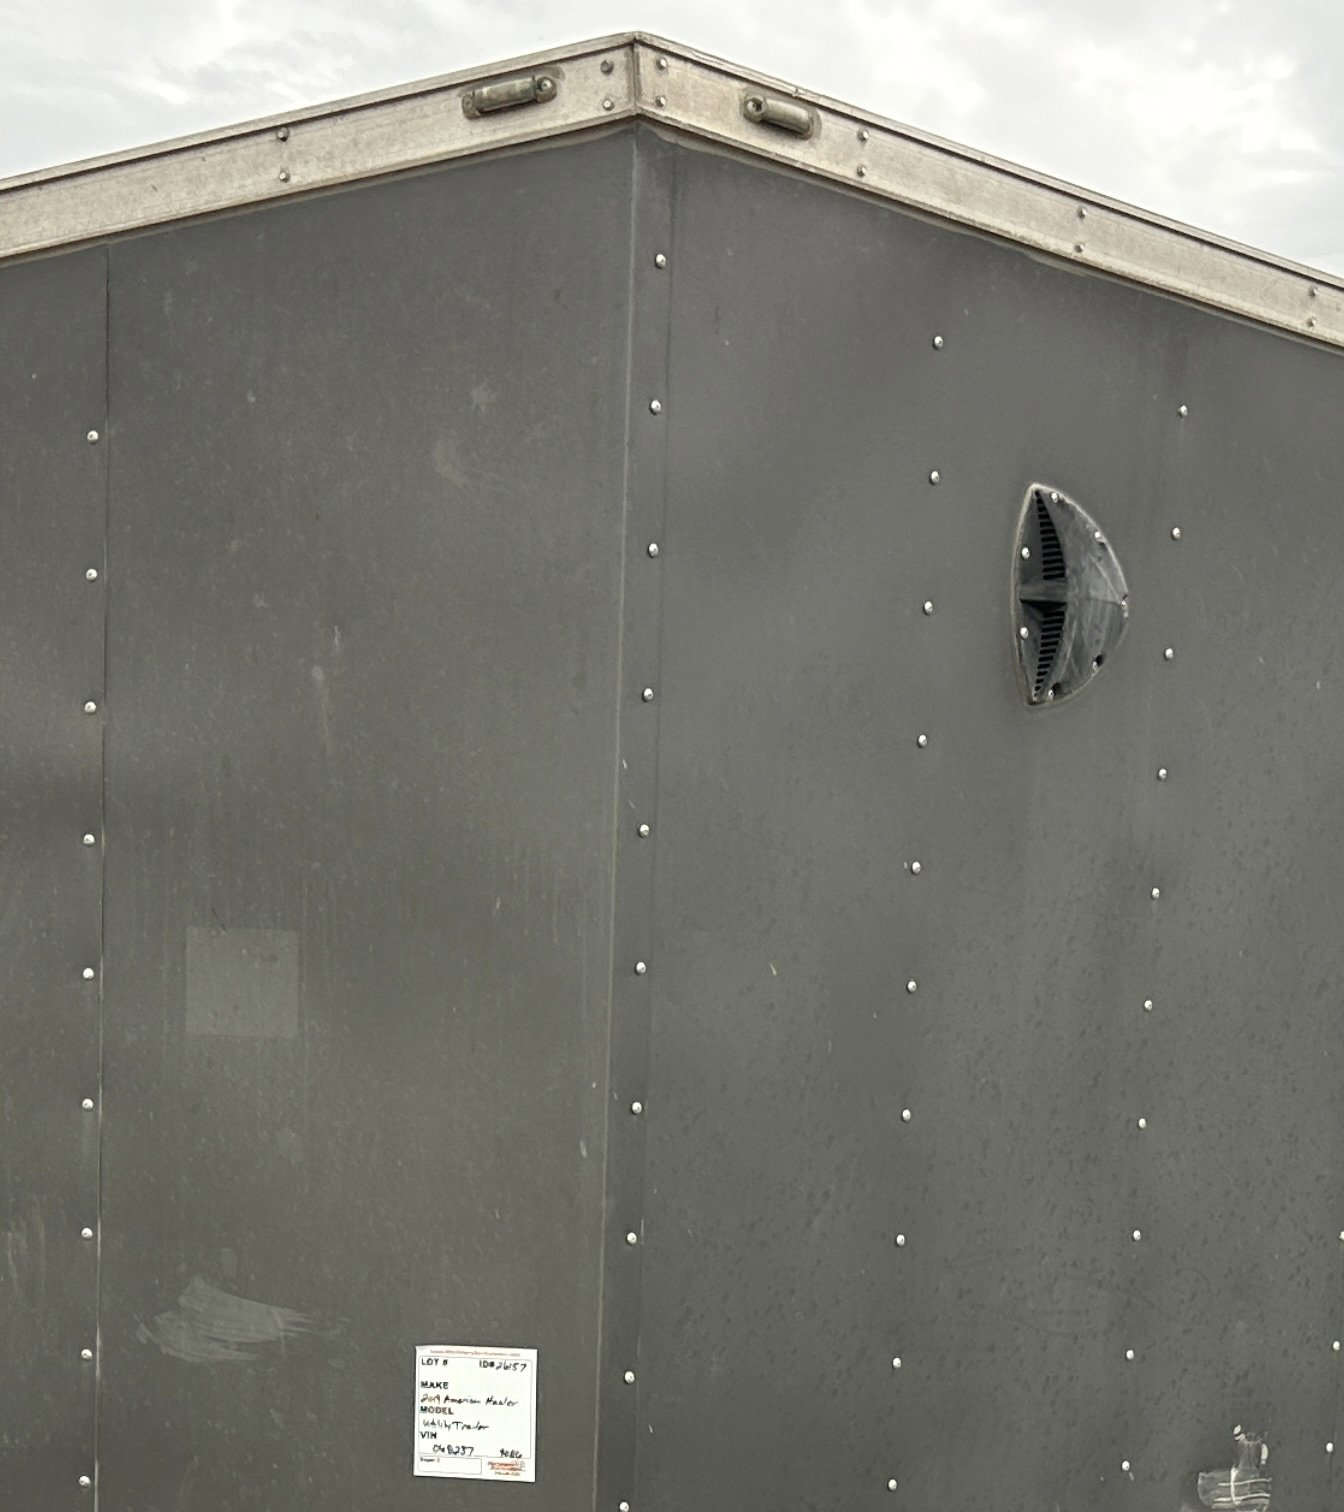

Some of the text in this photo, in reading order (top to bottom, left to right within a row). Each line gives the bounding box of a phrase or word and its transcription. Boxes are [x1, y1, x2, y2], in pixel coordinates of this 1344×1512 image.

[421, 1358, 439, 1366] LOT
[420, 1381, 449, 1389] MAKE
[420, 1405, 454, 1415] MODEL
[420, 1431, 437, 1439] VIN
